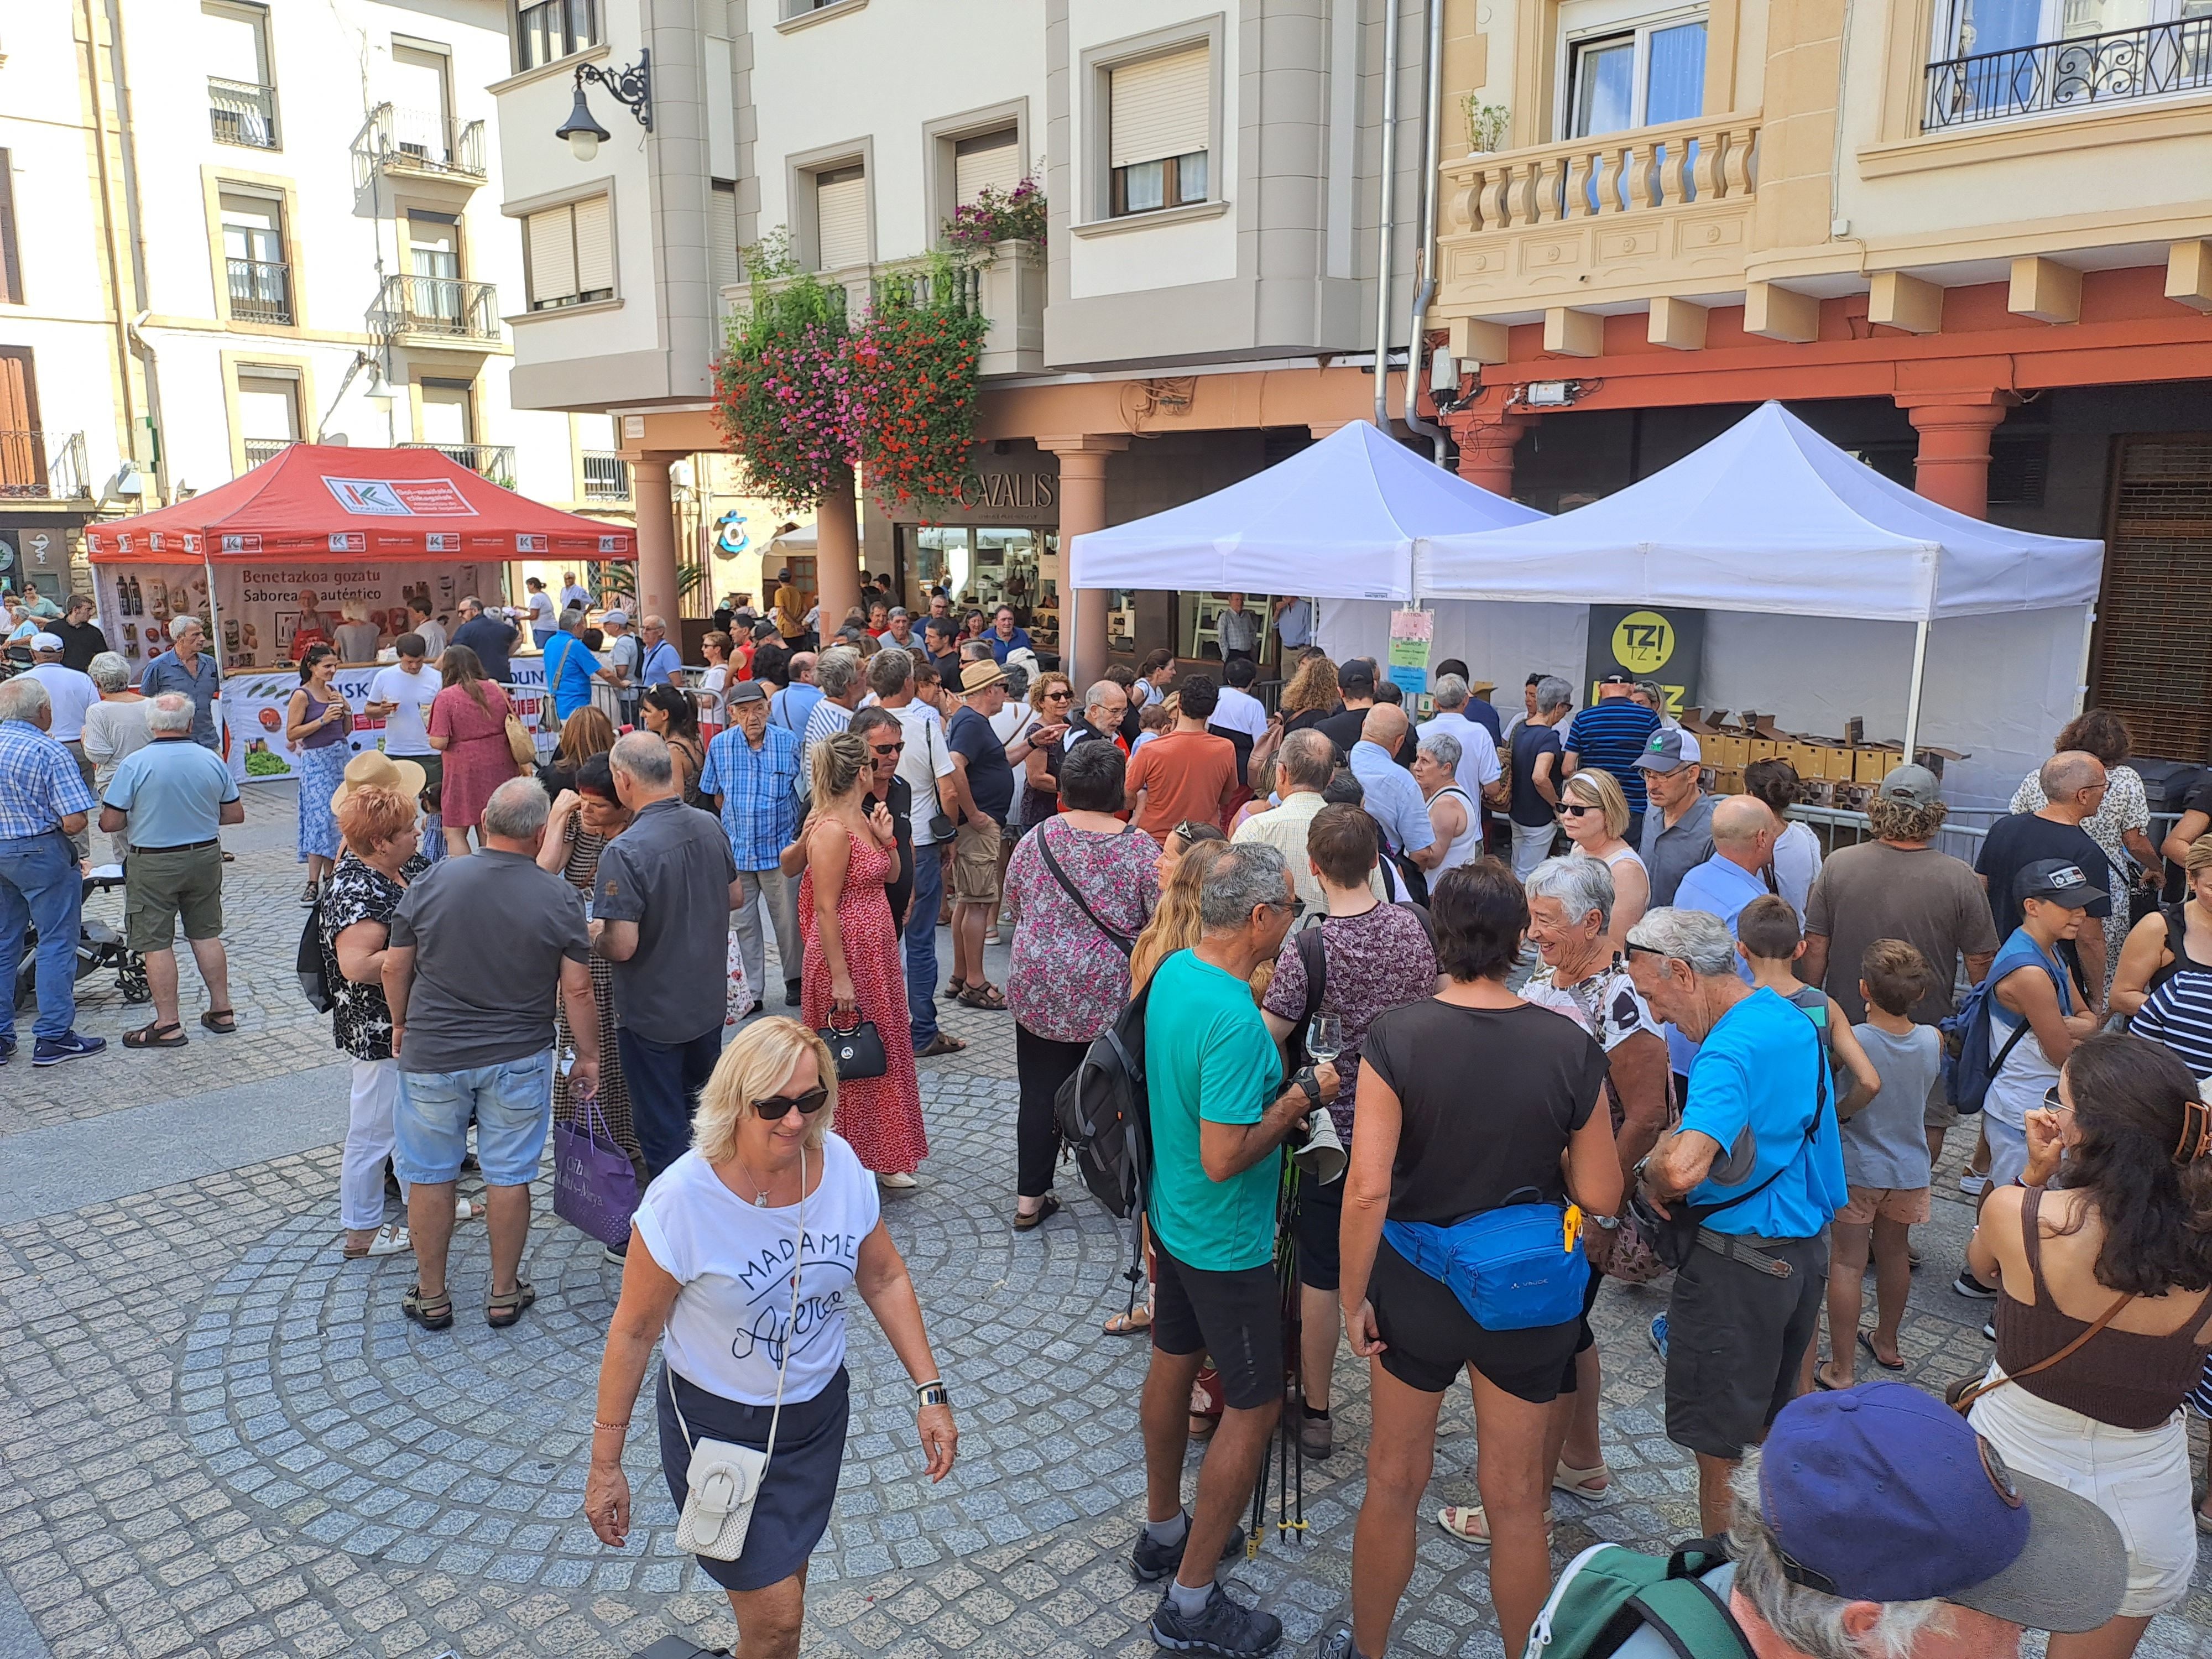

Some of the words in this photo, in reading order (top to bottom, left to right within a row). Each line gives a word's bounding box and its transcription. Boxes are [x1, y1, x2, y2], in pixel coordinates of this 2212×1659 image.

[242, 570, 328, 583] Benetazkoa
[334, 570, 380, 585] gozatu
[244, 589, 298, 602] Saborea
[320, 587, 381, 601] auténtico
[1627, 646, 1648, 661] TZ
[739, 1230, 856, 1291] MADAME
[1522, 1278, 1549, 1287] VAUDE
